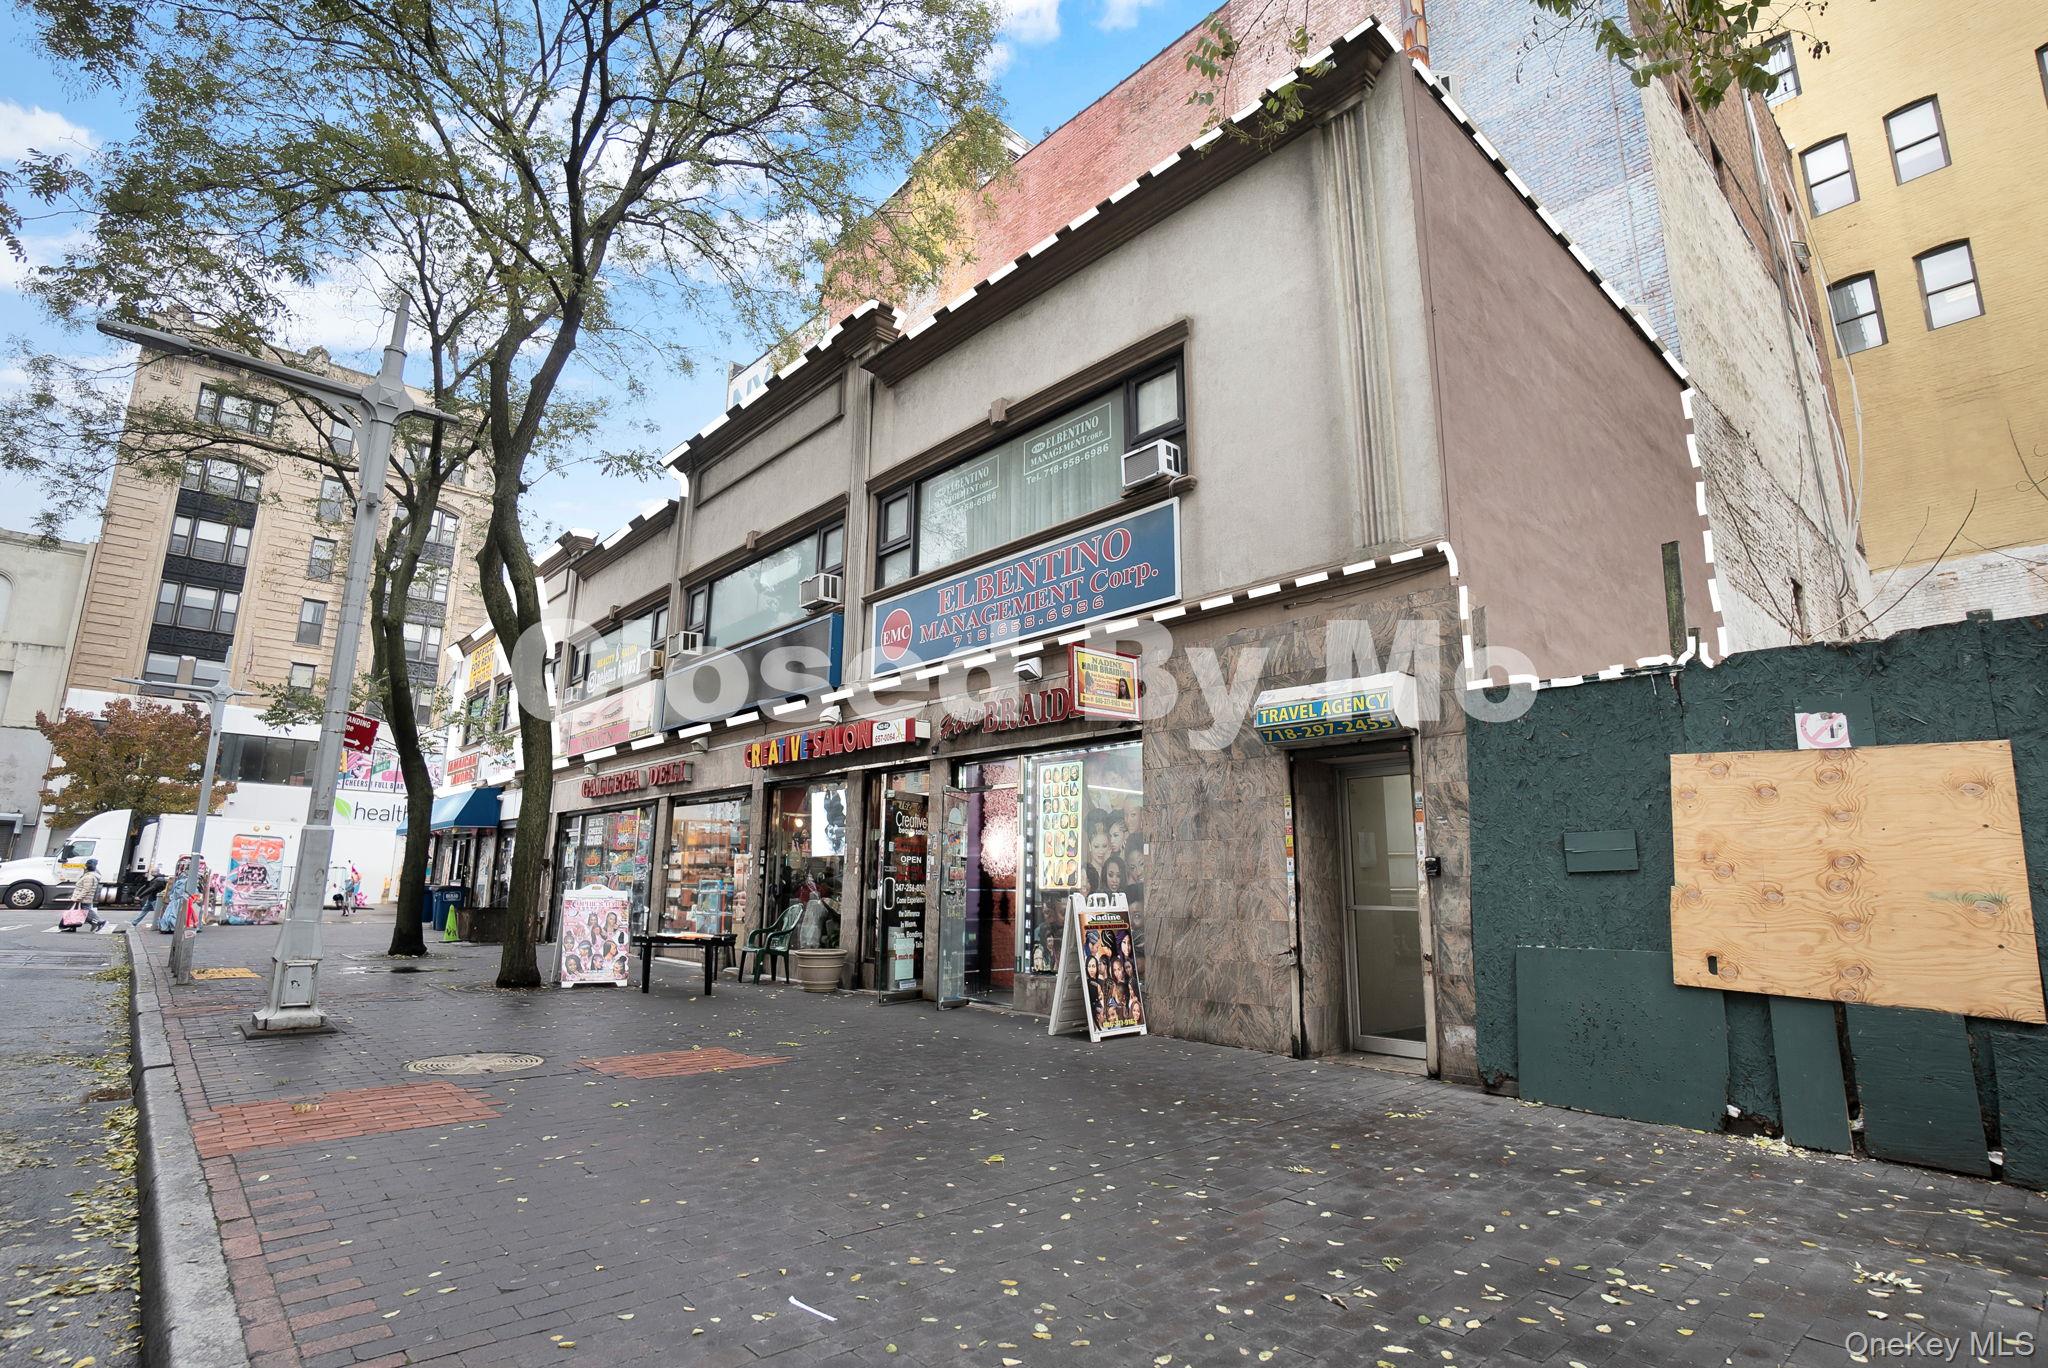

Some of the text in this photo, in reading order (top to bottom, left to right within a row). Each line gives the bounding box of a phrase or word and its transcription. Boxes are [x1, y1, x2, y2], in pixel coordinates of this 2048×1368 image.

[1046, 416, 1099, 449] ELBENTINO
[1031, 435, 1087, 467] MANAGEMENT
[1044, 443, 1109, 478] 718-658-6986
[936, 528, 1132, 617] ELBENTINO
[919, 560, 1160, 645] MANAGEMENT Corp.
[882, 624, 911, 646] EMC
[953, 596, 1105, 648] 718.658.6986
[1091, 656, 1123, 670] NADINE
[982, 687, 1070, 734] BRAID
[1260, 693, 1388, 724] TRAVEL AGENCY
[745, 719, 872, 769] CREATIVE SALON
[1262, 716, 1393, 742] 718-297-2455
[345, 779, 368, 788] CHEERS
[648, 760, 687, 787] DELI
[895, 811, 928, 830] Creative
[900, 855, 922, 864] OPEN
[1089, 914, 1121, 922] Nadine
